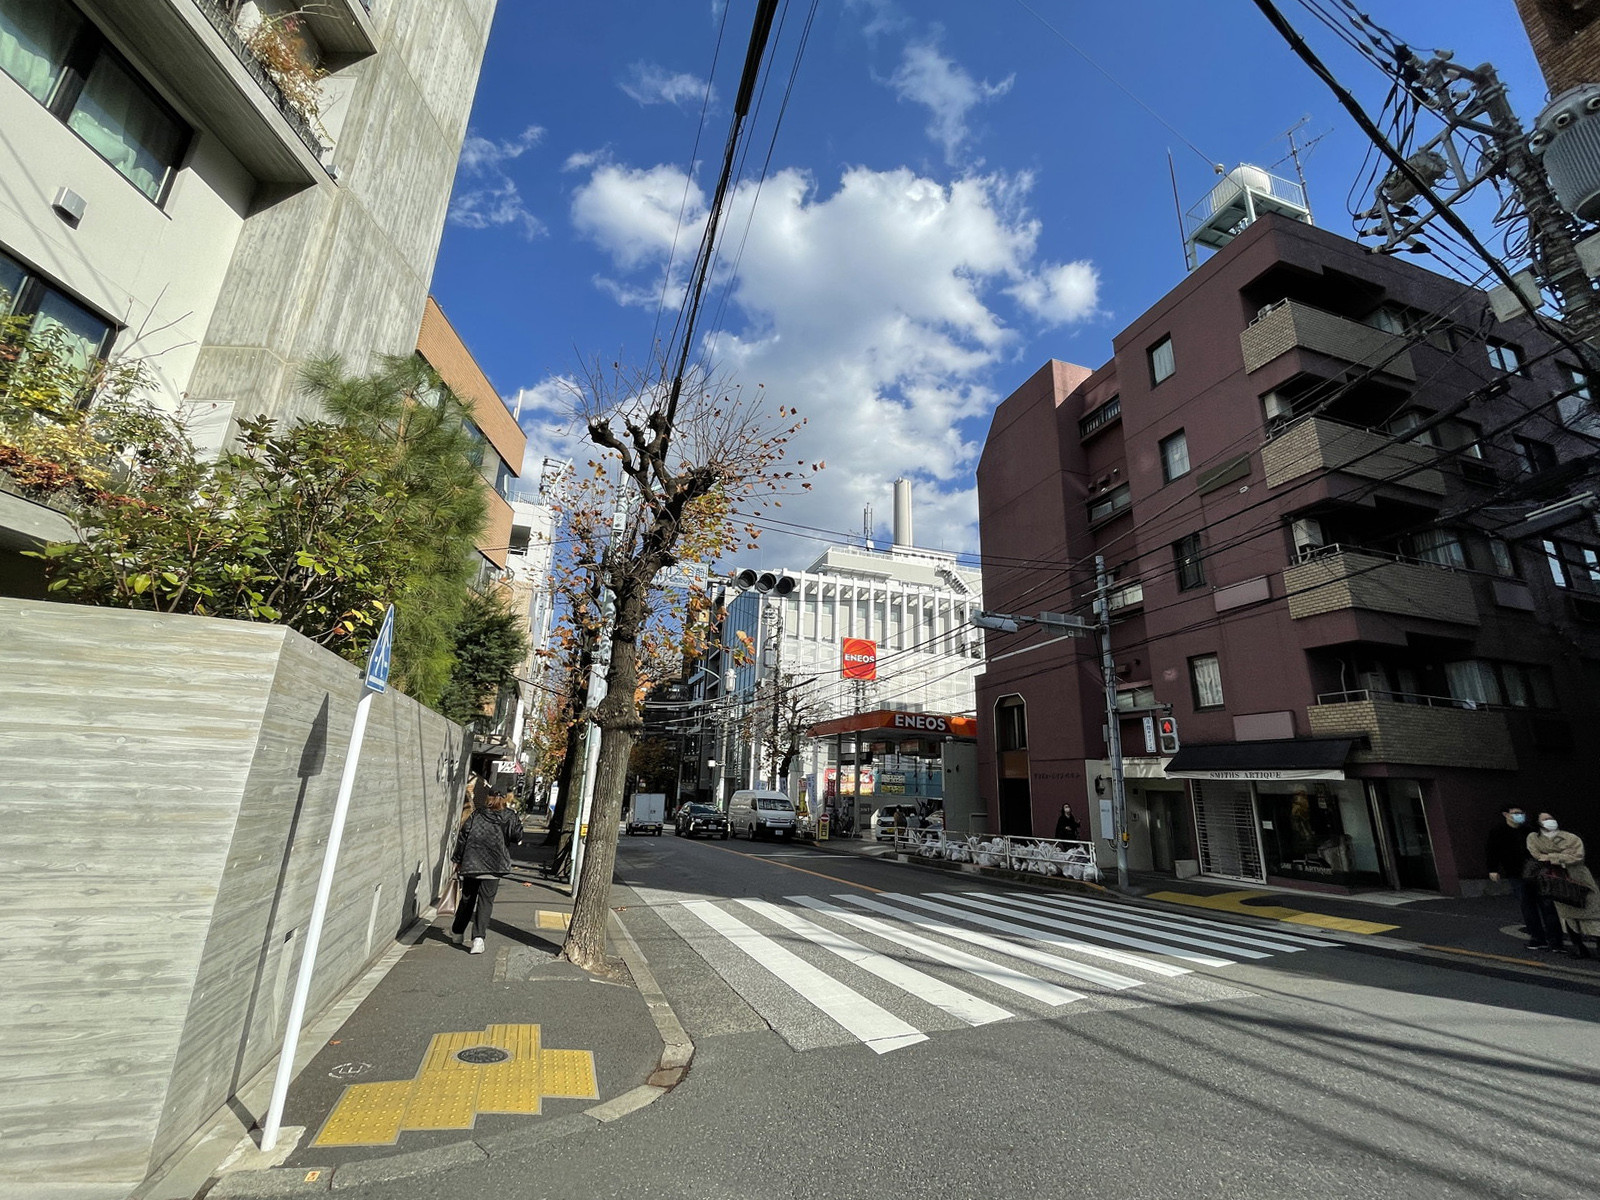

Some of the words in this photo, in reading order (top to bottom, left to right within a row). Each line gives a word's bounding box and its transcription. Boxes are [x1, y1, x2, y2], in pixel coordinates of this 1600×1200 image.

[844, 653, 875, 663] ENEOS
[895, 714, 946, 731] ENEOS
[1209, 771, 1240, 779] SMITHS
[1243, 771, 1282, 780] ARTIQUE
